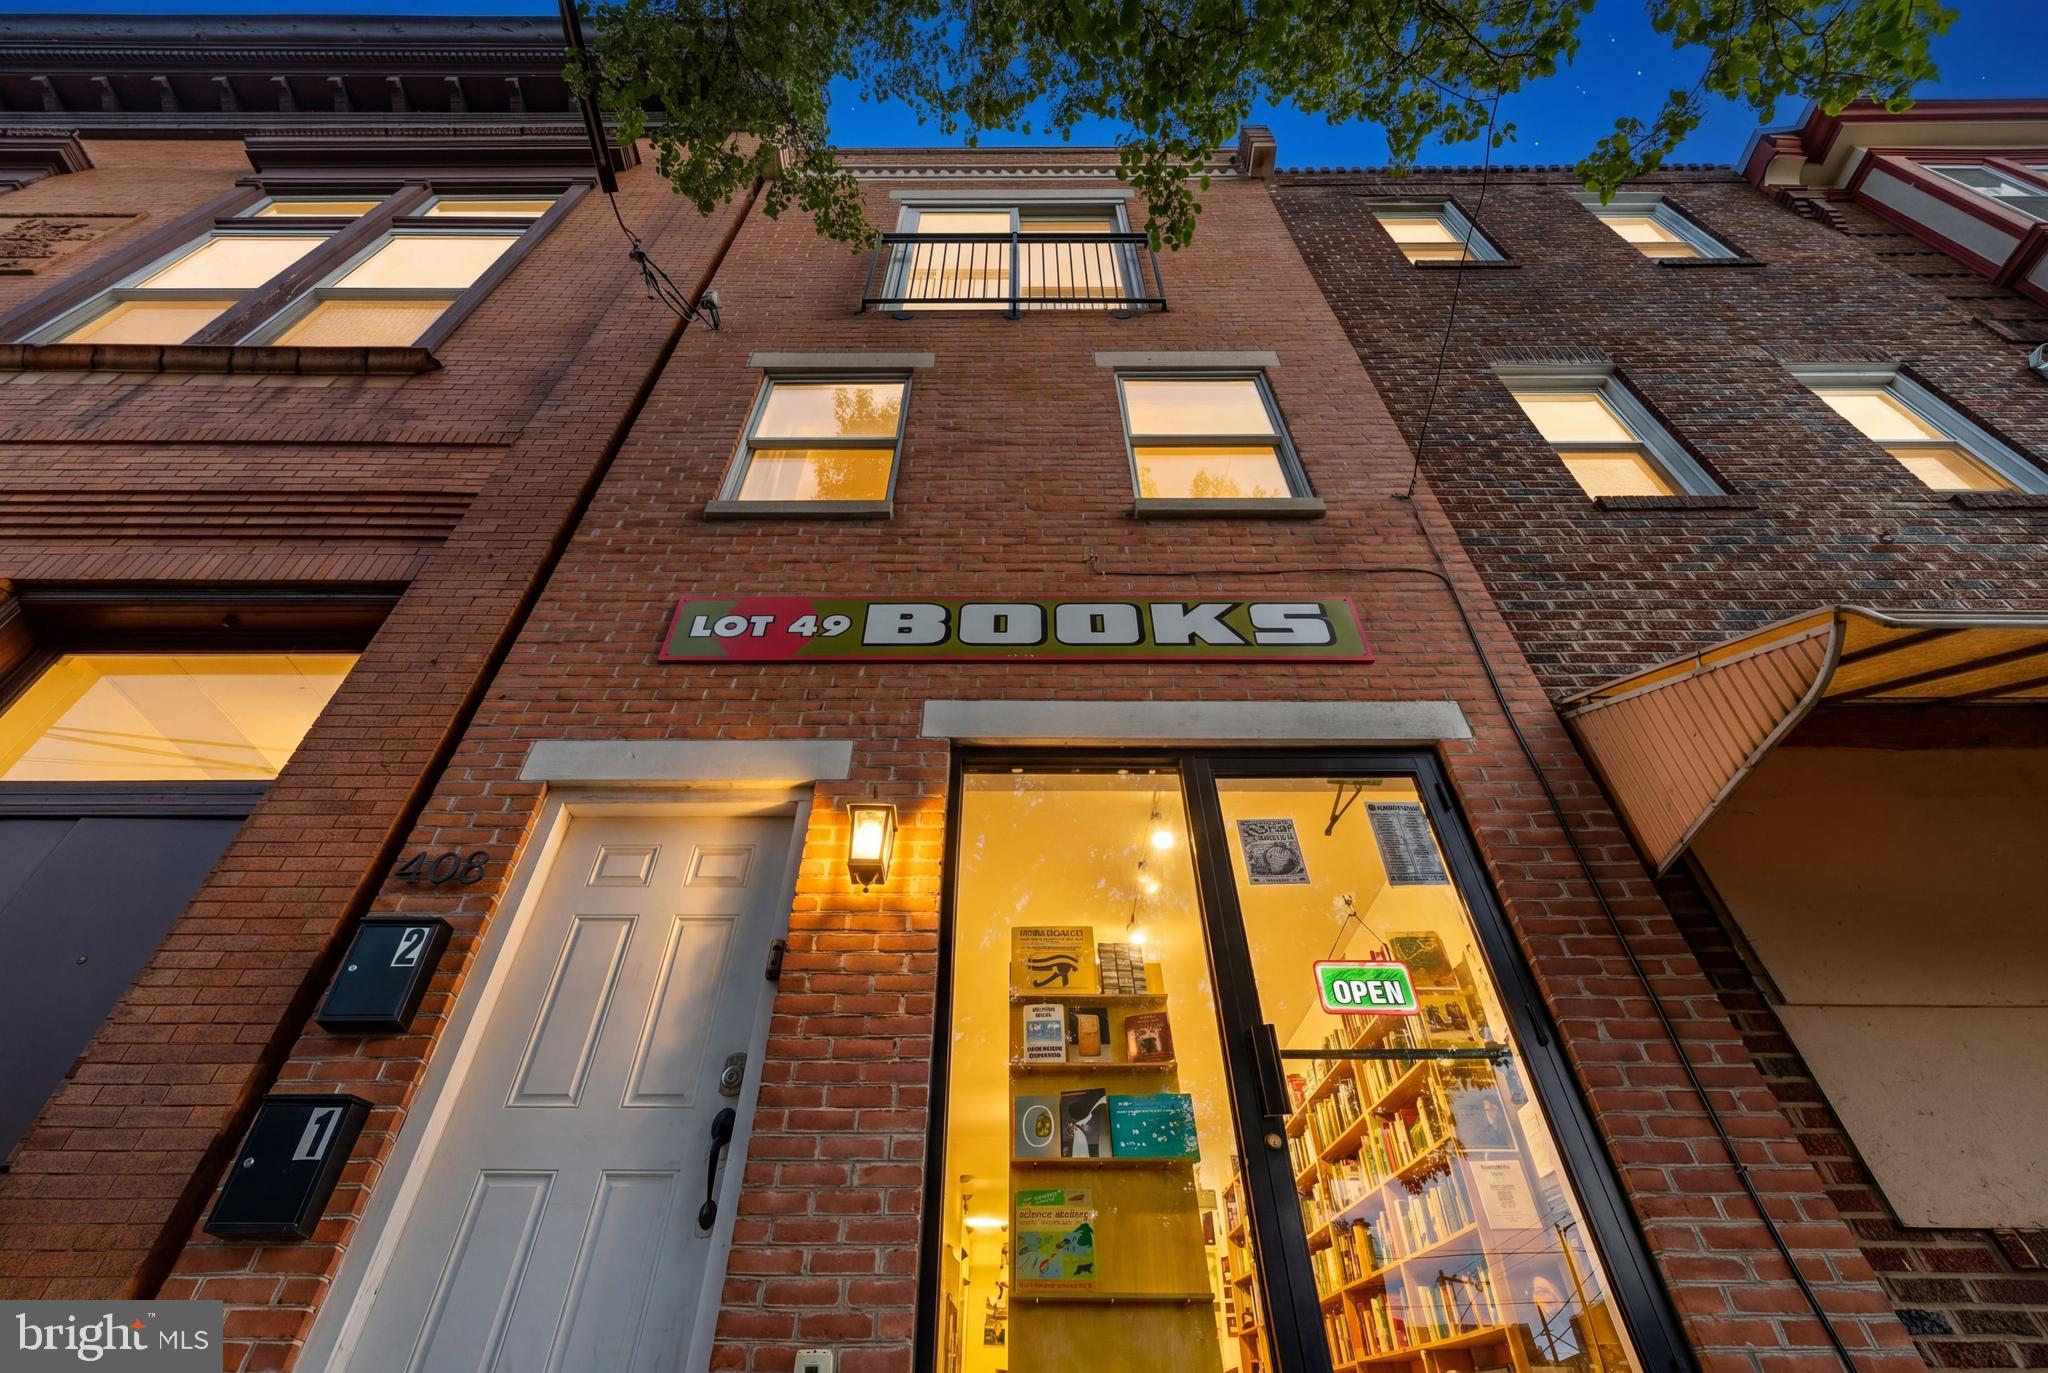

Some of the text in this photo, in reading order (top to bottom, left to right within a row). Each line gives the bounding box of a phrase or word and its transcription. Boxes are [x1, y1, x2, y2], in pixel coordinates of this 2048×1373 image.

[688, 602, 1336, 647] LOT 49 BOOKS
[396, 850, 490, 884] 408
[402, 929, 426, 966] 2
[1331, 979, 1406, 1005] OPEN
[306, 1110, 333, 1159] 1
